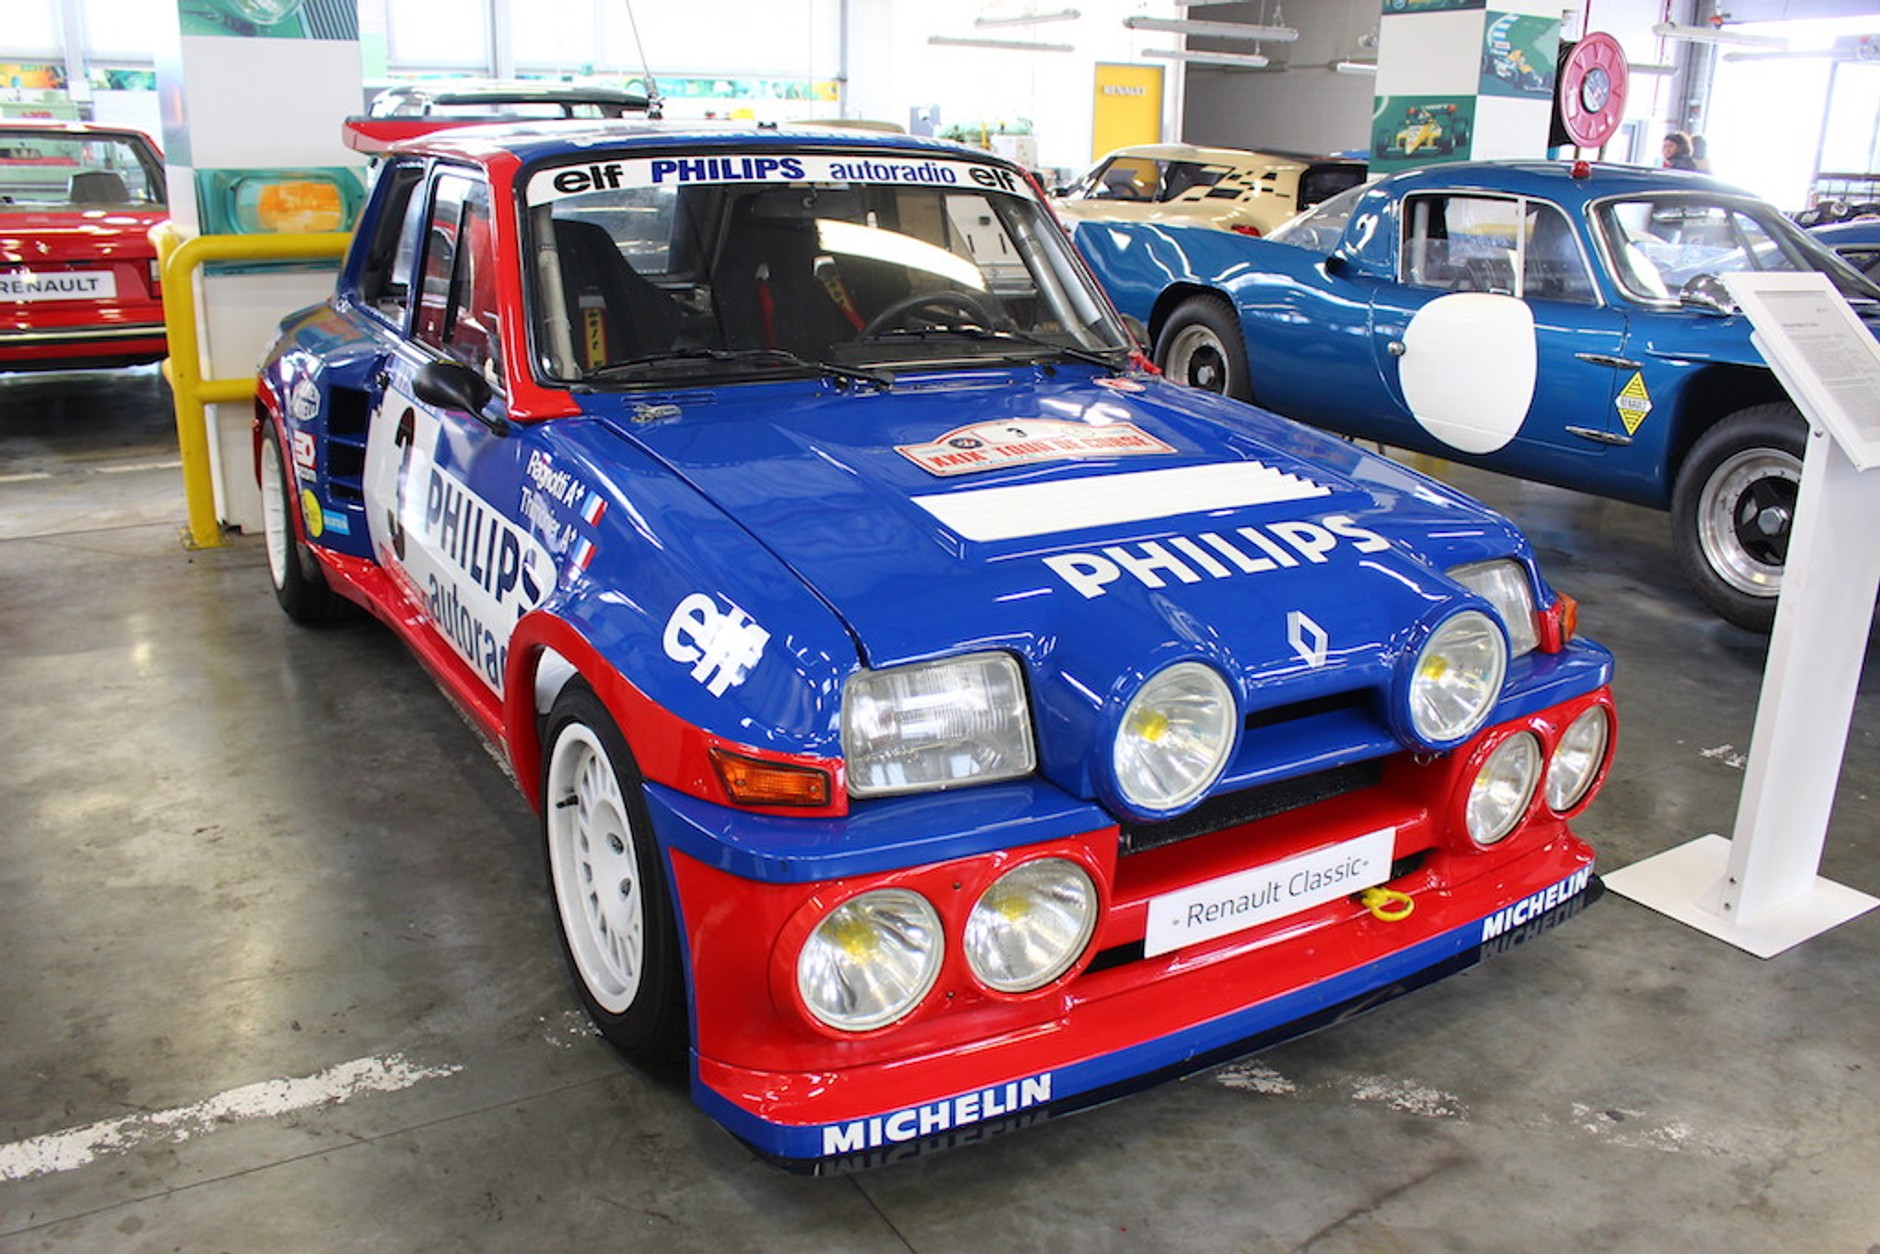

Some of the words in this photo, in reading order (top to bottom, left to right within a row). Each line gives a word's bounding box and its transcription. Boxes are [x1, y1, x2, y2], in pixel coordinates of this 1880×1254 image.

[553, 164, 624, 193] elf
[651, 158, 806, 183] PHILIPS
[830, 160, 957, 184] autoradio
[968, 166, 1016, 193] elf
[425, 466, 541, 620] PHILIPS
[1041, 515, 1392, 600] PHILIPS
[1187, 881, 1282, 928] Renault
[1288, 856, 1362, 898] Classic
[1481, 866, 1590, 942] MICHELIN
[822, 1072, 1052, 1156] MICHELIN
